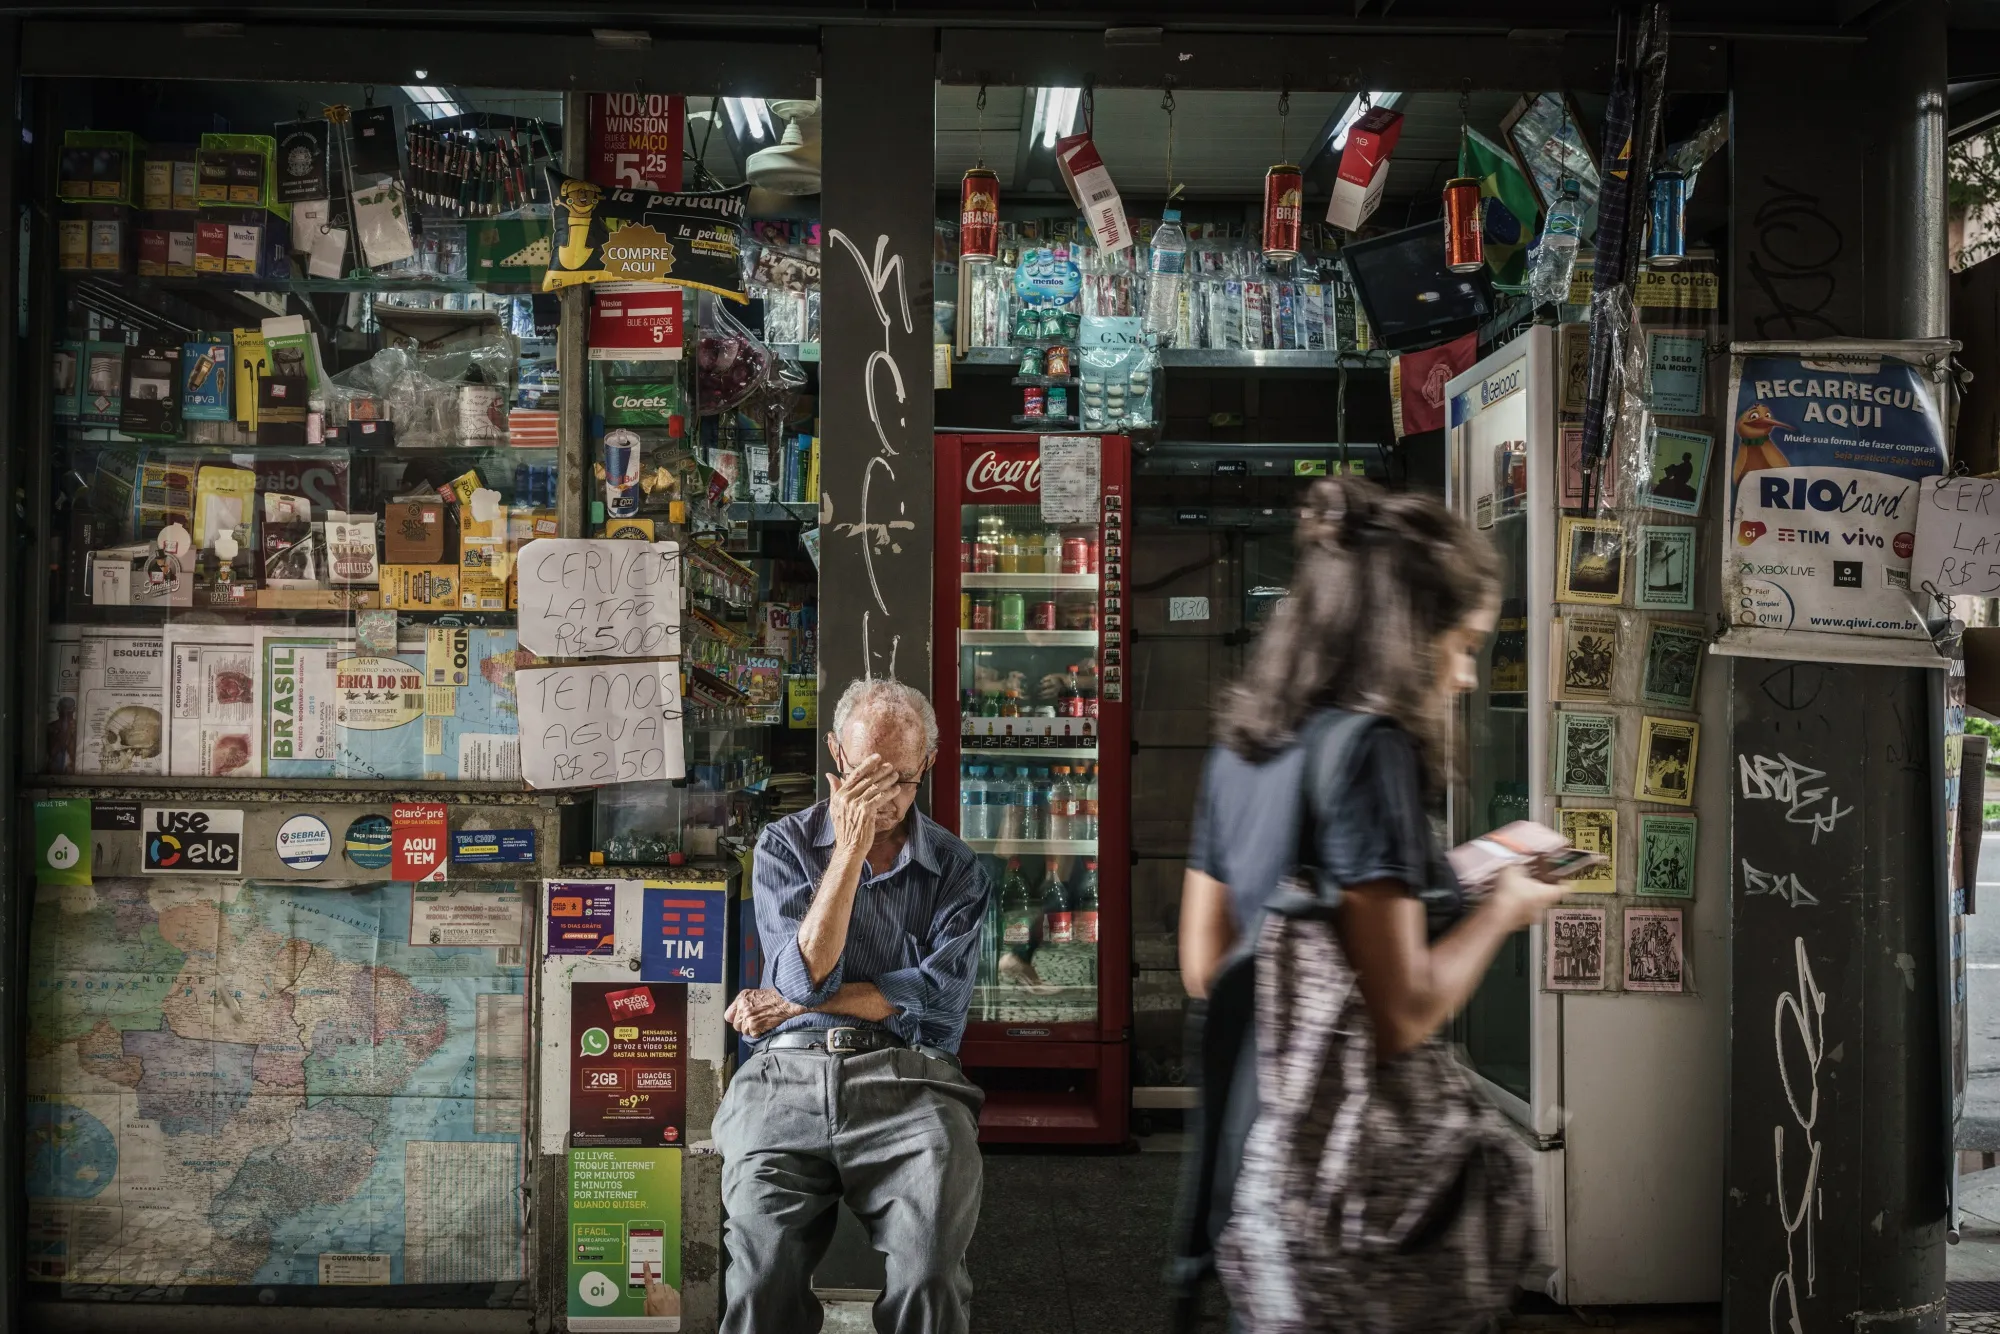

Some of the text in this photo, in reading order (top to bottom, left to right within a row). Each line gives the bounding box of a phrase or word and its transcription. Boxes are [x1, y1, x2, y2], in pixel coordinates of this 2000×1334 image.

[605, 93, 669, 116] NOVO!
[606, 117, 668, 133] WINSTON
[629, 135, 668, 153] MAÇO
[611, 189, 634, 202] la
[202, 229, 224, 239] Winston
[234, 231, 255, 241] Winston
[143, 236, 165, 246] Winston
[608, 247, 669, 260] COMPRE
[621, 261, 656, 273] AQUI
[1647, 273, 1718, 287] De Cordel
[627, 318, 643, 326] BLUE
[649, 318, 673, 326] CLASSIC
[1488, 369, 1520, 404] Gelopar
[612, 396, 667, 409] Clorets
[1755, 379, 1926, 414] RECARREGUE
[1804, 401, 1882, 428] AQUI
[1784, 434, 1936, 454] Mude sua forma de fazer compras!
[1834, 451, 1852, 461] Seja
[1854, 452, 1888, 464] prático!
[1890, 456, 1909, 466] Seja
[624, 470, 639, 483] Bull
[966, 451, 1040, 493] Coca-C
[1745, 528, 1884, 549] oi TIM vivo
[337, 563, 372, 574] PHILLIES
[537, 548, 677, 595] CERVEJA
[1757, 565, 1815, 577] XBOX LIVE
[1759, 614, 1783, 624] QIWI
[1810, 616, 1918, 632] www.qiwi.com.br
[358, 658, 379, 666] MAPA
[336, 672, 422, 690] ÉRICA DO SUL
[536, 672, 675, 713] TEMOS
[273, 649, 294, 758] BRASIL
[543, 717, 657, 749] AGUA
[156, 811, 210, 833] use
[290, 831, 326, 839] SEBRAE
[456, 835, 473, 844] TIM
[474, 834, 497, 843] CHIP
[403, 838, 436, 851] AQUI
[54, 846, 68, 860] oi
[187, 840, 234, 864] elo
[405, 852, 435, 865] TEM
[280, 899, 385, 934] OCEANO ATLÂNTICO
[663, 940, 704, 959] TIM
[679, 966, 695, 978] 4G
[142, 976, 206, 985] NORTE
[613, 994, 647, 1009] prezão
[628, 1001, 650, 1012] nele
[591, 1073, 618, 1086] 2GB
[637, 1072, 672, 1081] LIGAÇÕES
[574, 1152, 617, 1160] OI LIVRE.
[574, 1162, 656, 1170] TROQUE INTERNET
[574, 1171, 636, 1179] POR MINUTOS
[574, 1181, 623, 1189] E MINUTOS
[574, 1191, 638, 1199] POR INTERNET
[574, 1201, 649, 1209] QUANDO QUISER.
[577, 1226, 611, 1236] É FÁCIL.
[331, 1254, 381, 1262] CONVENÇÕES
[590, 1282, 605, 1297] oi
